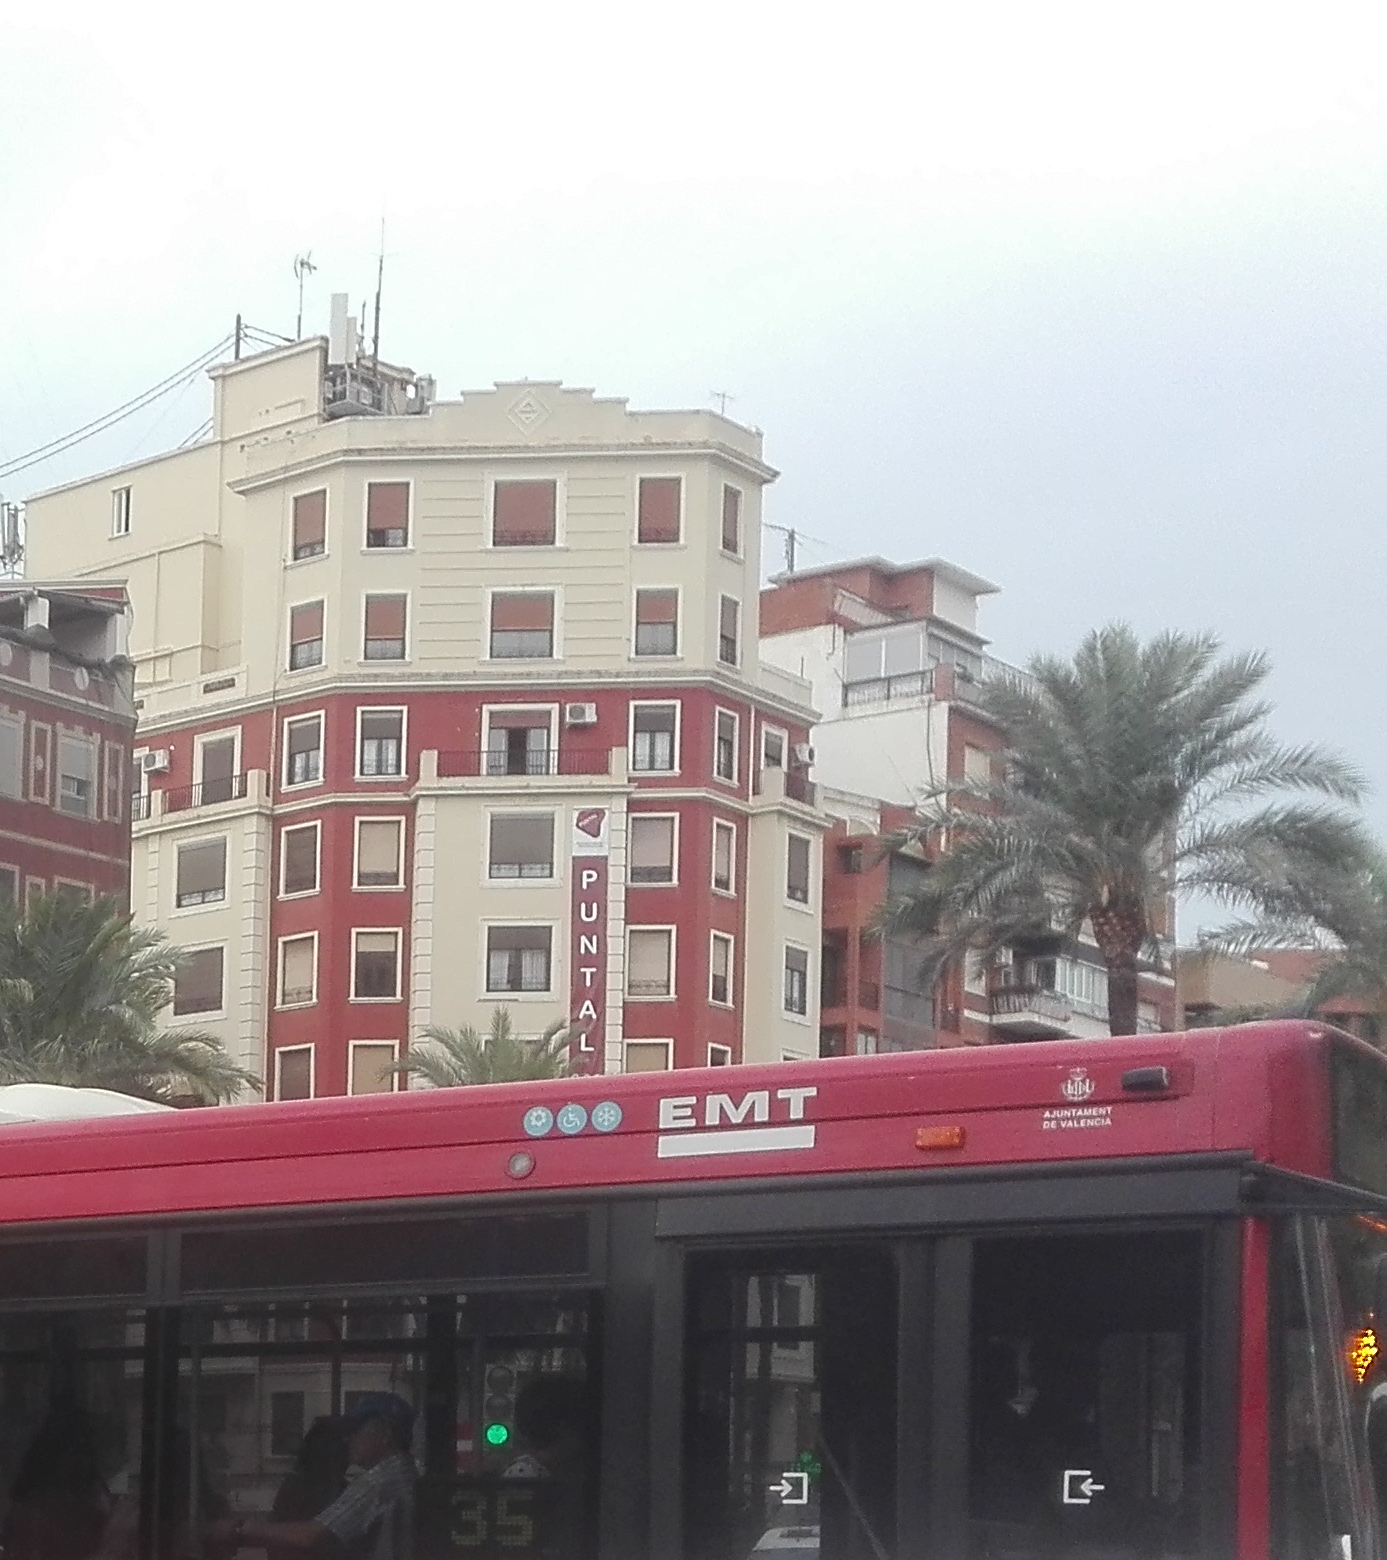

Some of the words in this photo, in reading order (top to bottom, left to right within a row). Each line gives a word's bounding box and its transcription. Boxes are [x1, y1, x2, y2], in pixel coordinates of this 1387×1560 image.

[579, 869, 598, 1052] PUNTAL
[658, 1086, 818, 1129] EMT
[1043, 1106, 1112, 1118] AJUNTAMENT
[1043, 1120, 1057, 1129] DE
[1060, 1117, 1112, 1128] VALENCIA
[451, 1490, 534, 1546] 35
